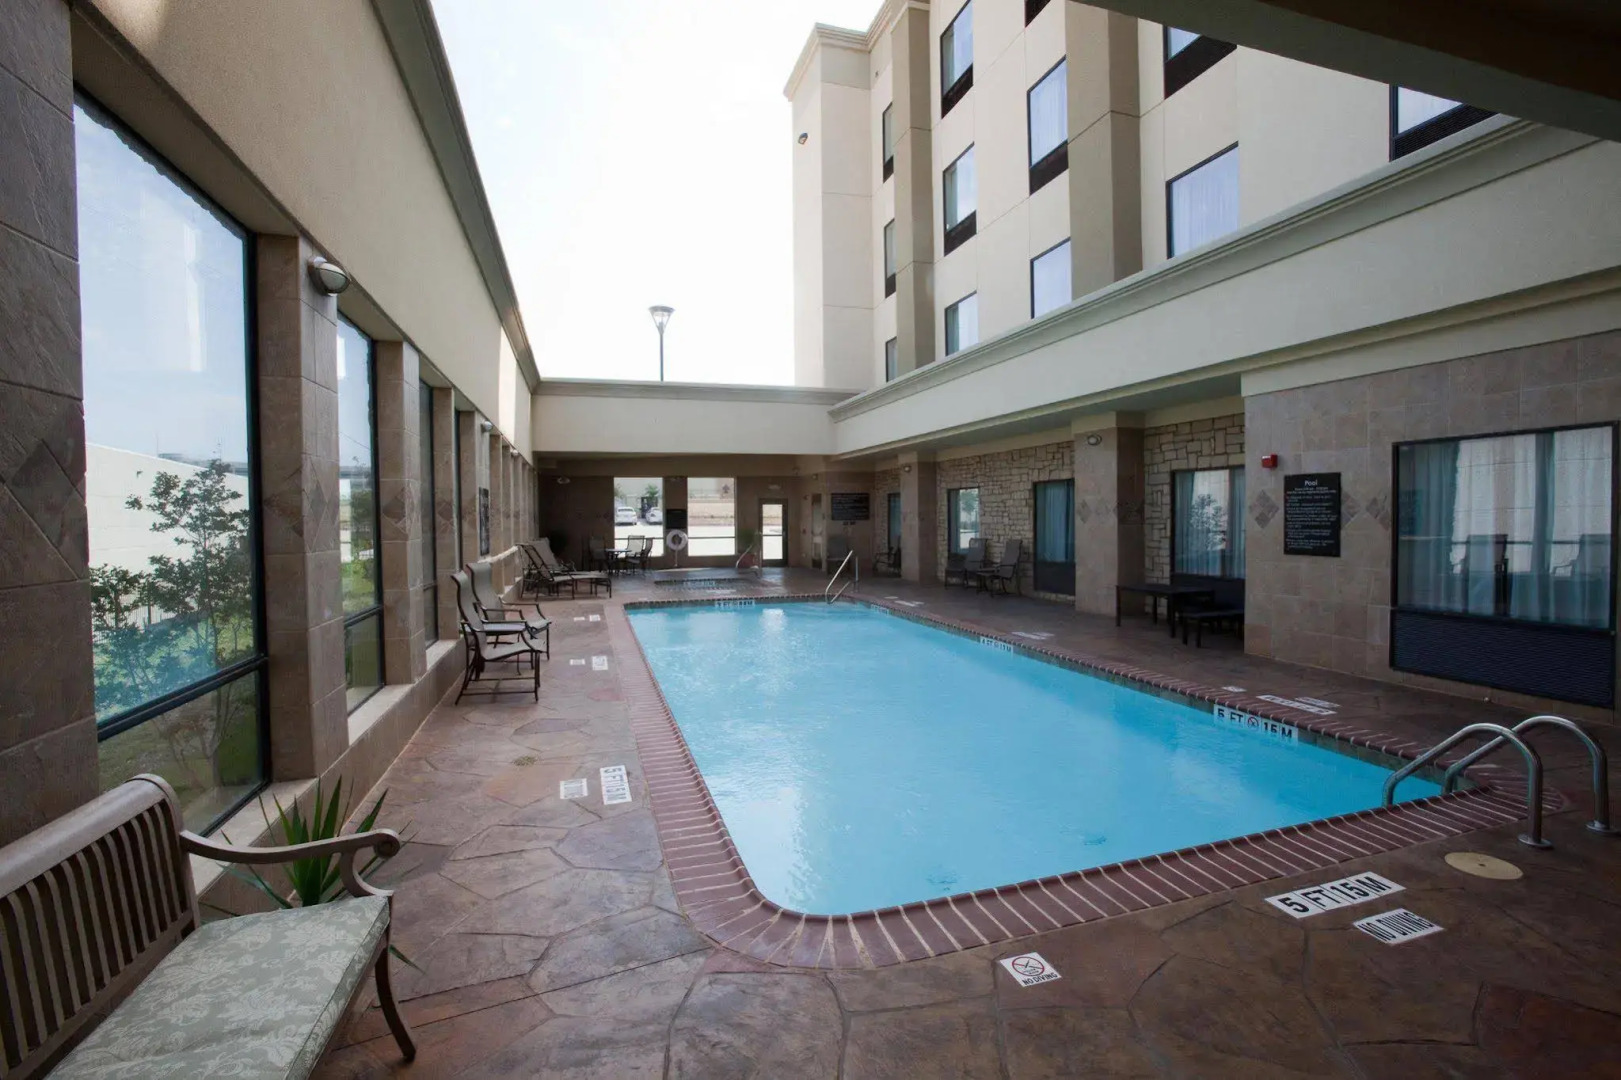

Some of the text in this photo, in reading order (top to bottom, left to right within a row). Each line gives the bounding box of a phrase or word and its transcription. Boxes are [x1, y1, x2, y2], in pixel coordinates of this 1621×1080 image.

[1304, 479, 1318, 487] Pool
[1230, 711, 1244, 723] FT
[1278, 897, 1309, 913] 5
[1358, 911, 1435, 942] NO DIVING
[1021, 972, 1058, 985] NO DIVING
